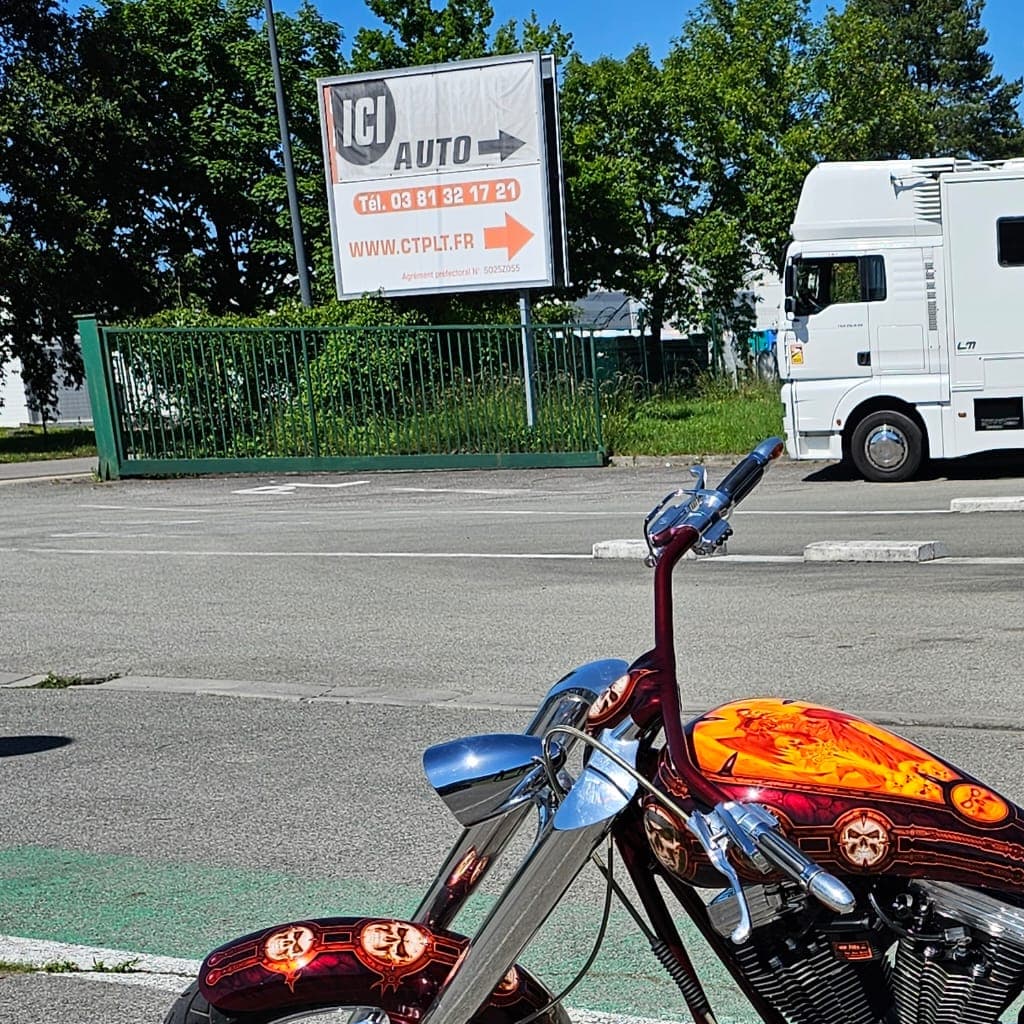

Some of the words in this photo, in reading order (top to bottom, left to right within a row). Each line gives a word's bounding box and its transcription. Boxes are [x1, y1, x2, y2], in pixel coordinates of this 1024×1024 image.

[343, 96, 386, 147] ICI
[394, 135, 471, 170] AUTO
[358, 194, 386, 212] Tél.
[391, 192, 412, 209] 03
[416, 189, 437, 207] 81
[443, 187, 464, 204] 32
[470, 184, 490, 202] 17
[495, 181, 516, 200] 21
[349, 233, 474, 258] WWW.CTPLT.FR
